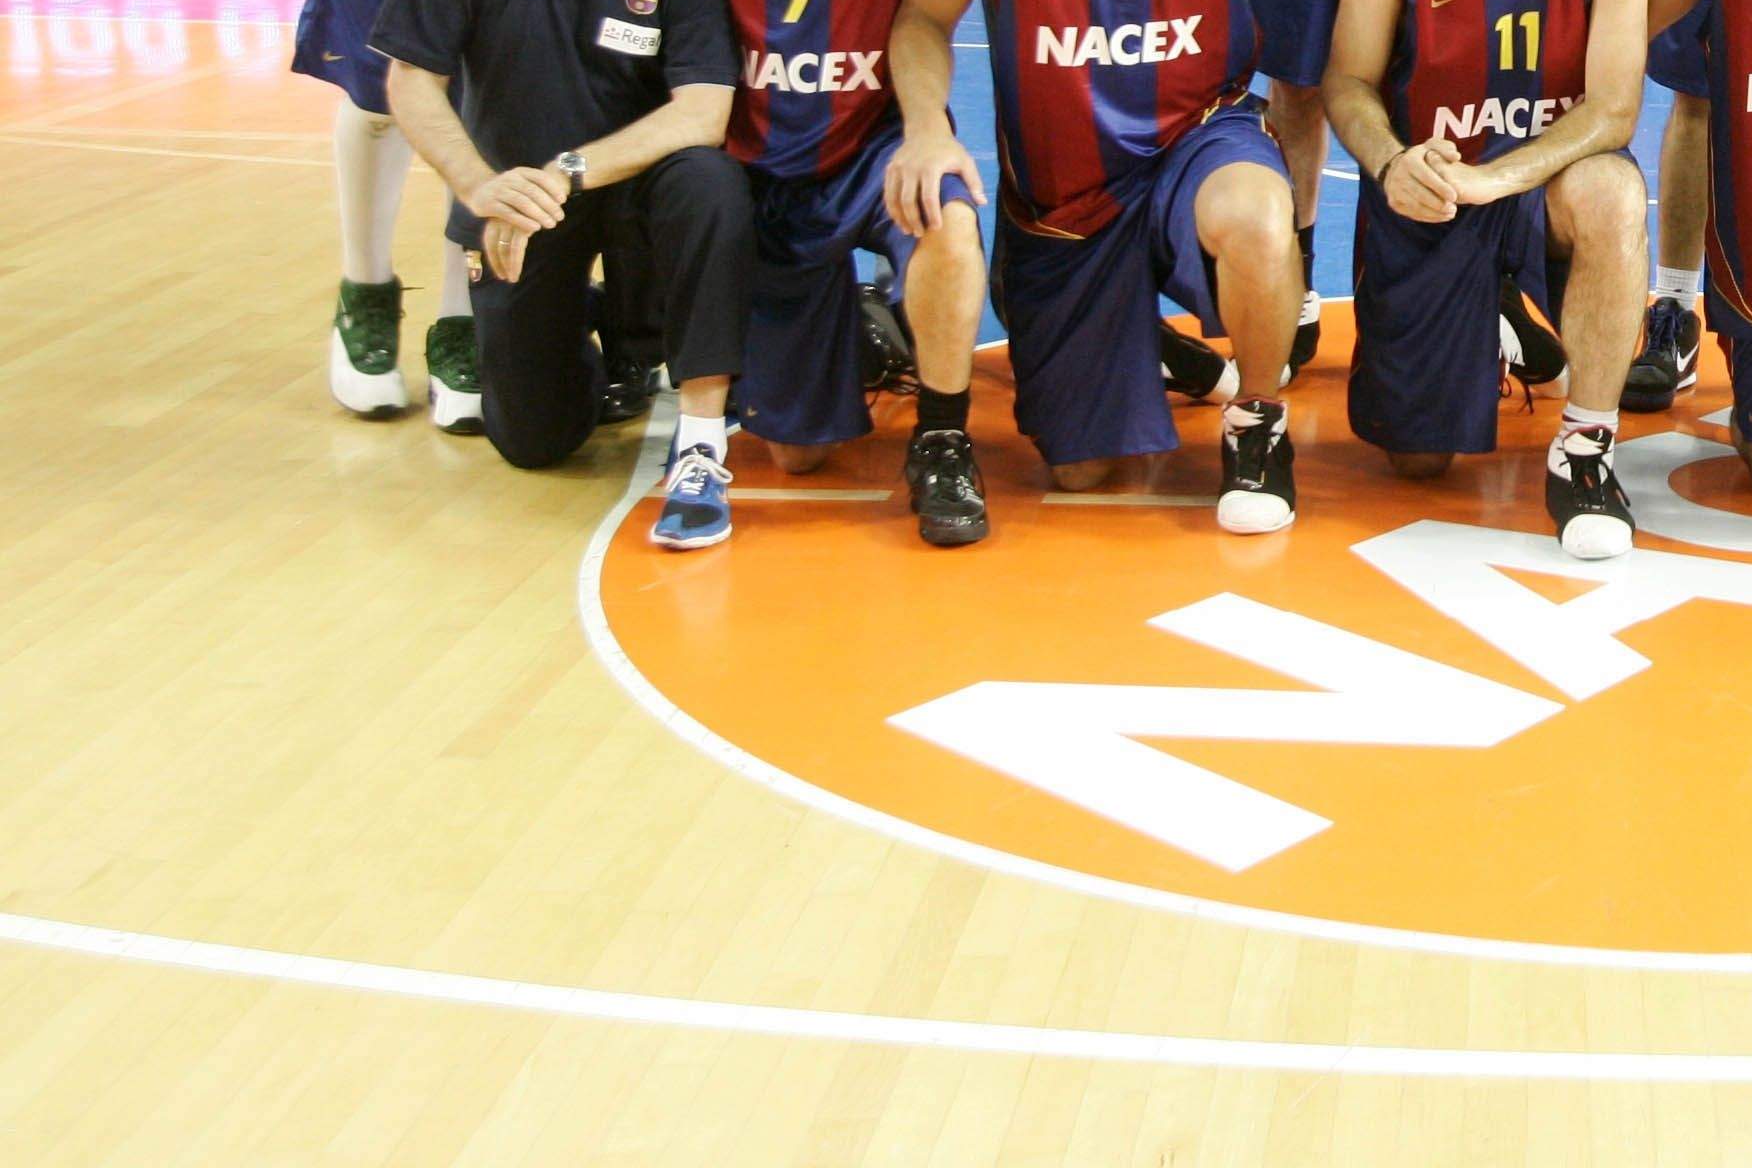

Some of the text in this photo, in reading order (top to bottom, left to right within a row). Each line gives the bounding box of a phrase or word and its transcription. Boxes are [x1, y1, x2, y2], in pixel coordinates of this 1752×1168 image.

[1035, 14, 1203, 67] NACEX
[1494, 10, 1541, 72] 11
[1433, 93, 1586, 139] NACE
